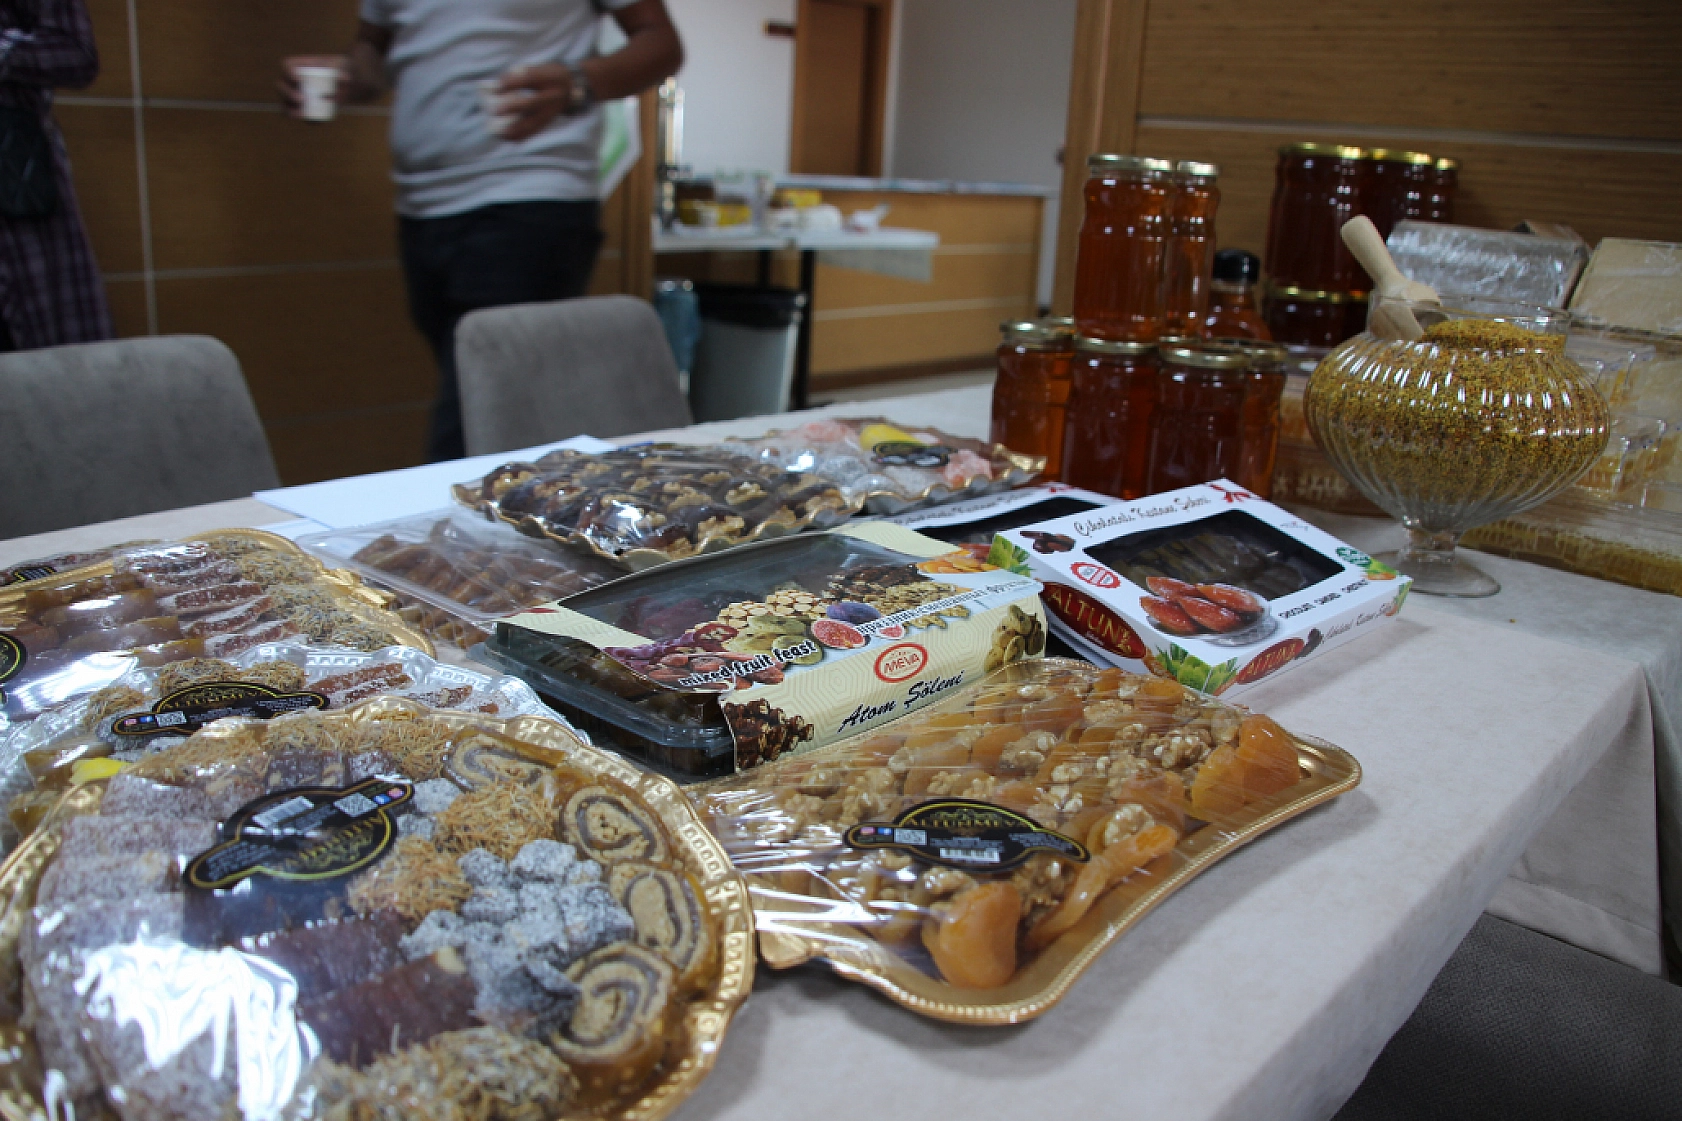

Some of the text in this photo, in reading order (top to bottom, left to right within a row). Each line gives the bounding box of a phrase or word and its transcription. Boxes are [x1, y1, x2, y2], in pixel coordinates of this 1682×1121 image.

[678, 638, 818, 686] mixed fruit feast
[883, 653, 920, 674] MEVA
[836, 702, 896, 734] Atom
